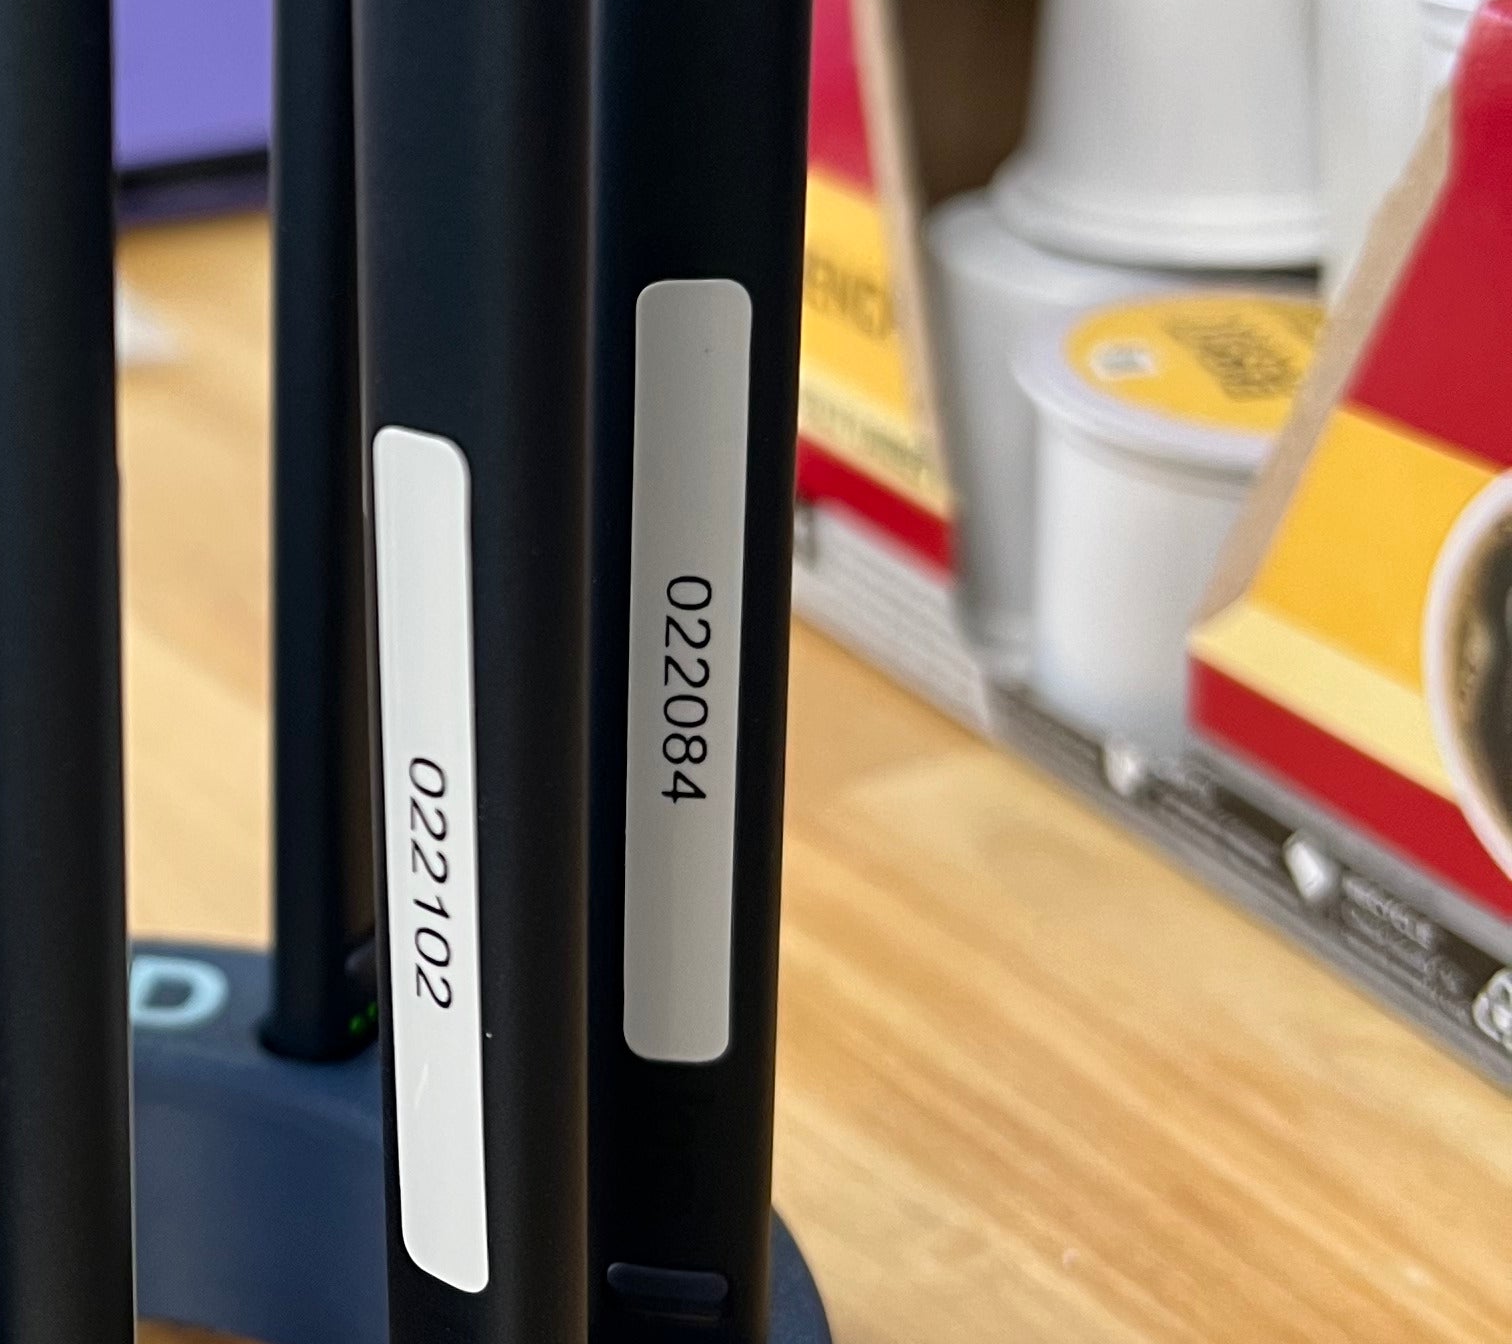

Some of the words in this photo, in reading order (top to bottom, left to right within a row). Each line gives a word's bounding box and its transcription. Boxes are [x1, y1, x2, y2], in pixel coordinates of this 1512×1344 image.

[661, 575, 713, 805] 022084
[128, 954, 230, 1029] D
[407, 756, 453, 1011] 022102
